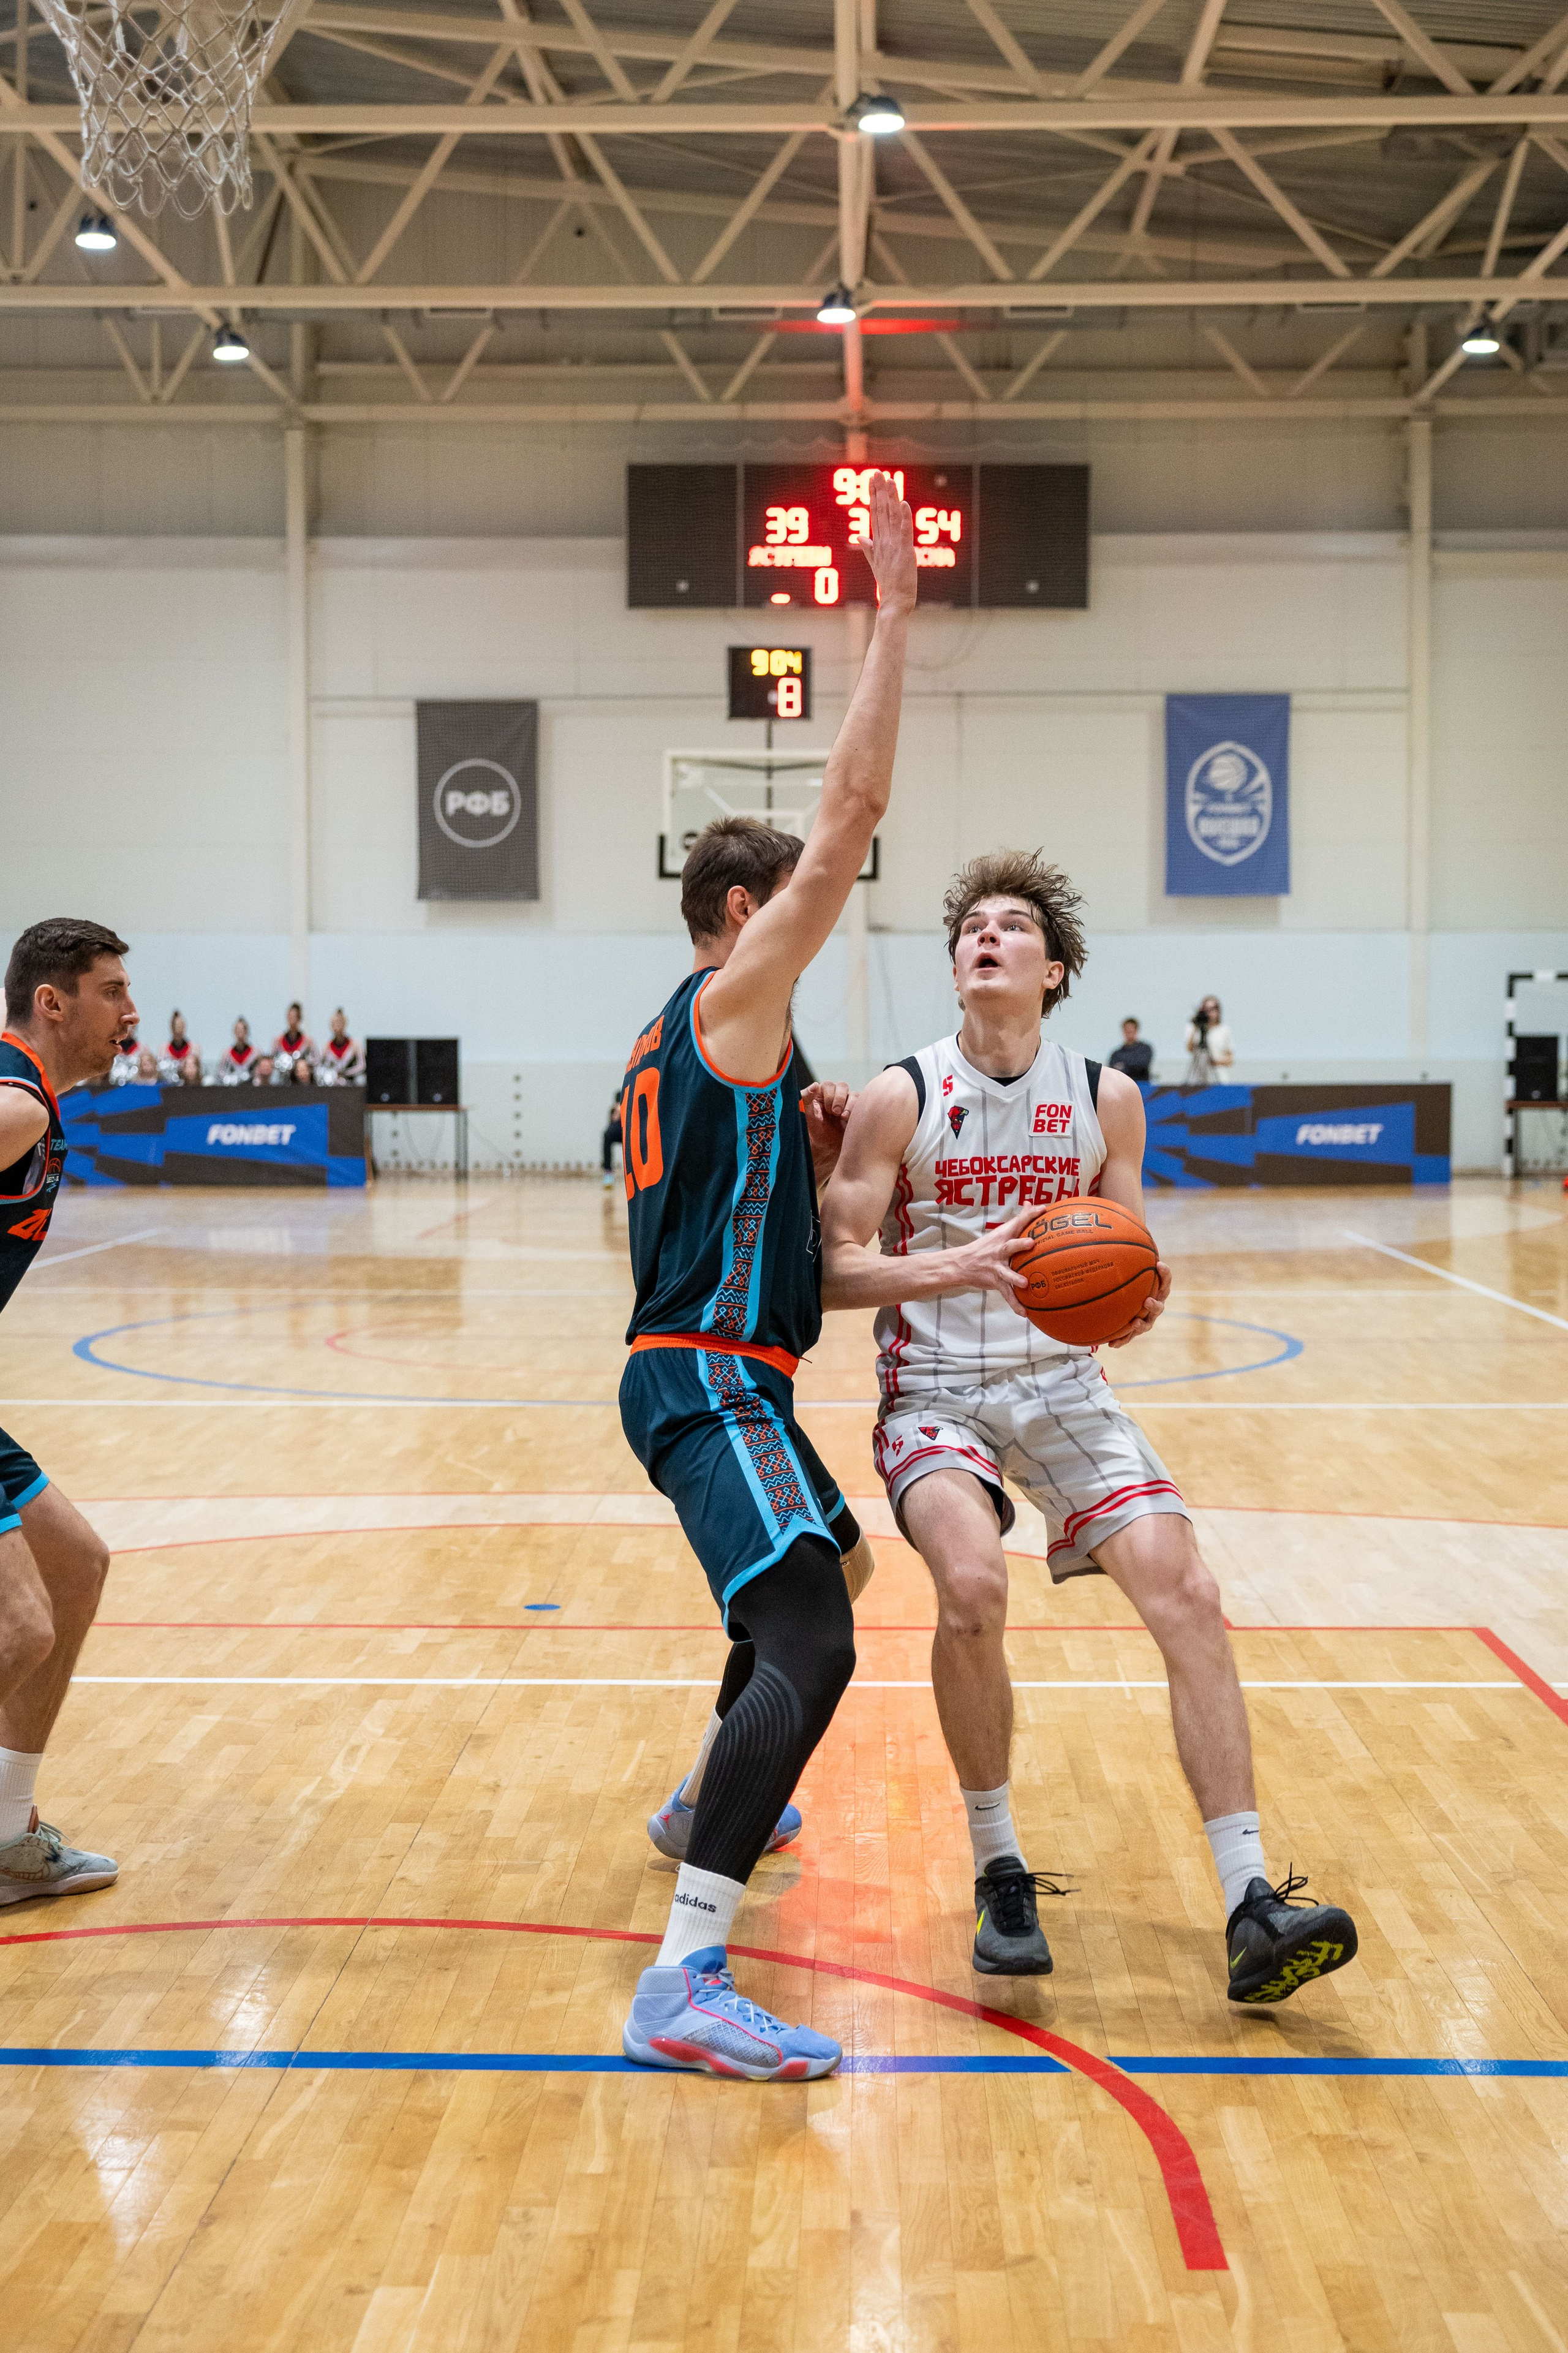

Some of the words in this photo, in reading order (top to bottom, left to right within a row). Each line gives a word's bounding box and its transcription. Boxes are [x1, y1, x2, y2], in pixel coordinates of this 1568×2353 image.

[766, 507, 809, 544] 39
[848, 507, 870, 545] 3
[915, 507, 961, 544] 54
[815, 567, 839, 604] 0
[777, 676, 802, 717] 8
[445, 790, 510, 815] РФБ
[943, 1075, 954, 1097] 5
[1035, 1103, 1072, 1119] FON
[206, 1124, 296, 1146] FONBET
[1032, 1118, 1071, 1133] BET
[1295, 1124, 1384, 1146] FONBET
[935, 1155, 1080, 1177] ЧЕБОКСАРСКИЕ
[934, 1175, 1080, 1206] ЯСТРЕБЫ
[1031, 1279, 1047, 1291] РФБ
[674, 1892, 717, 1913] adidas
